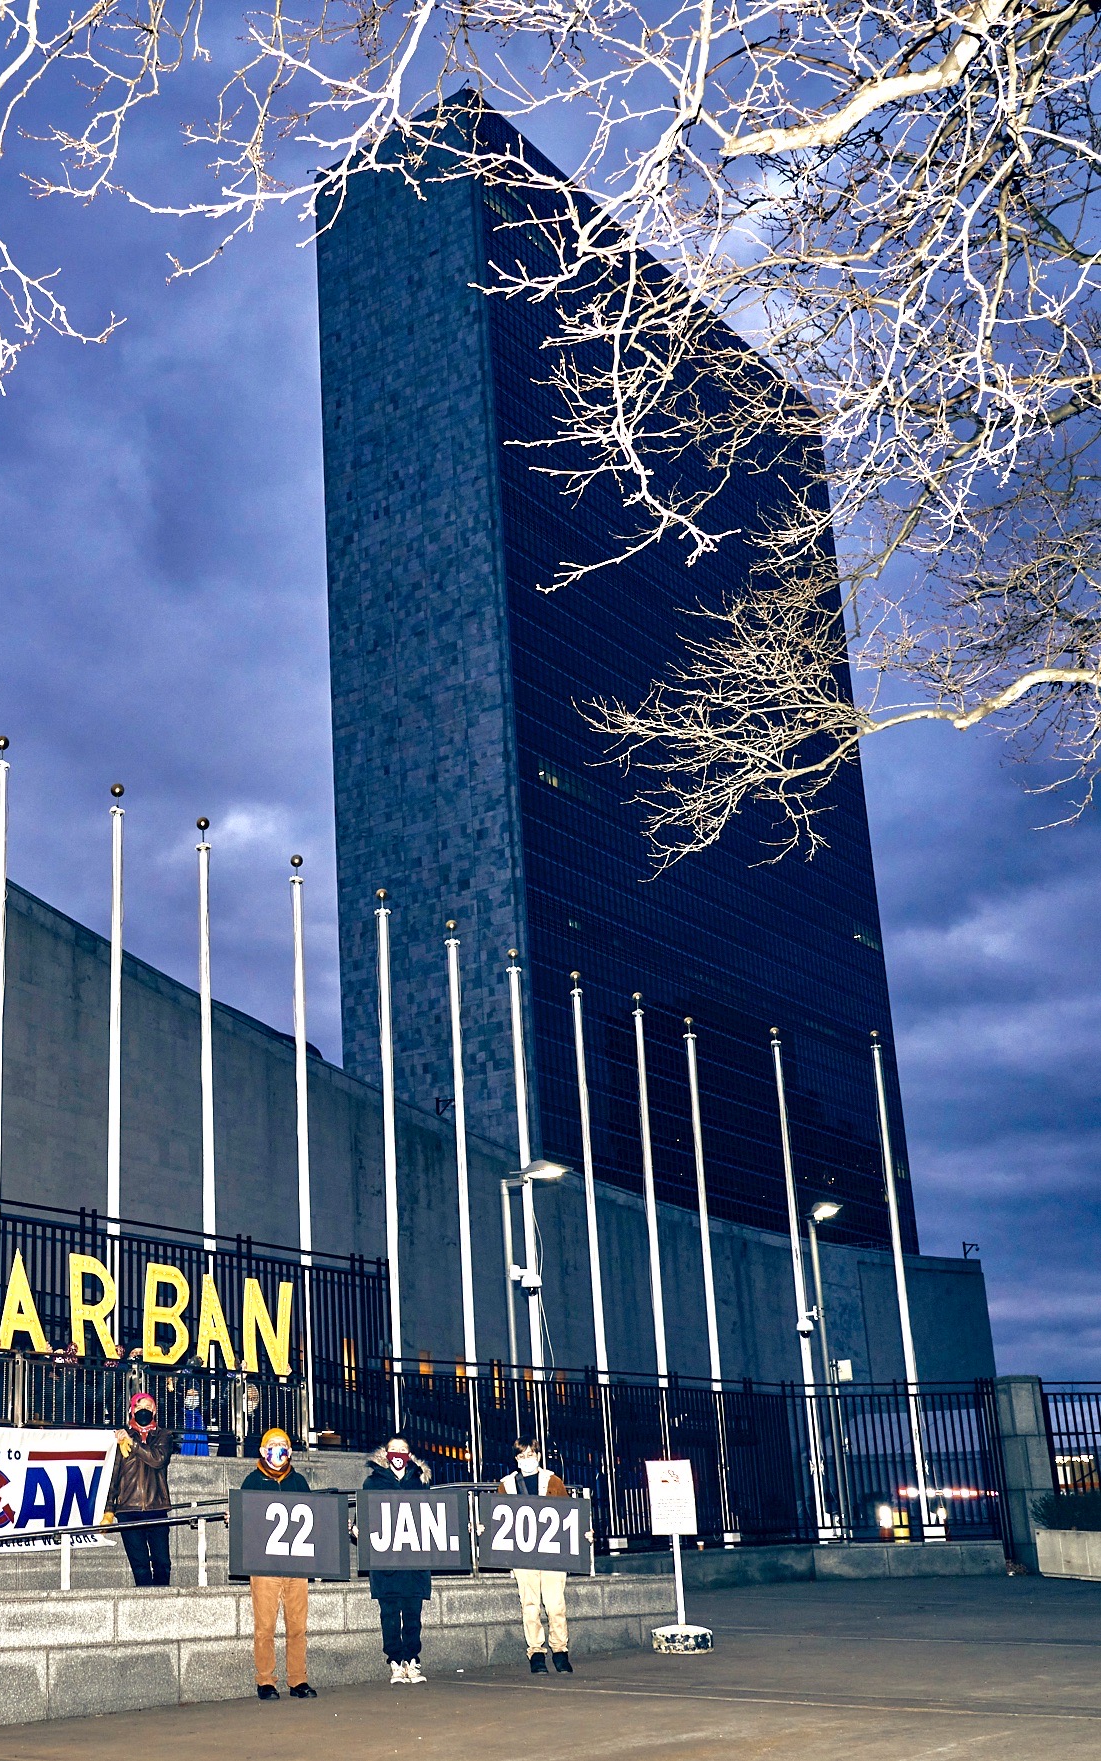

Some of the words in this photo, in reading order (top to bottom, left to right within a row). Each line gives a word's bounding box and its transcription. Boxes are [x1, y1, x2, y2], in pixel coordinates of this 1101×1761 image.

[7, 1448, 22, 1460] to
[41, 1533, 98, 1547] Wepons
[264, 1502, 315, 1557] 22
[369, 1502, 460, 1552] JAN.
[491, 1504, 580, 1556] 2021
